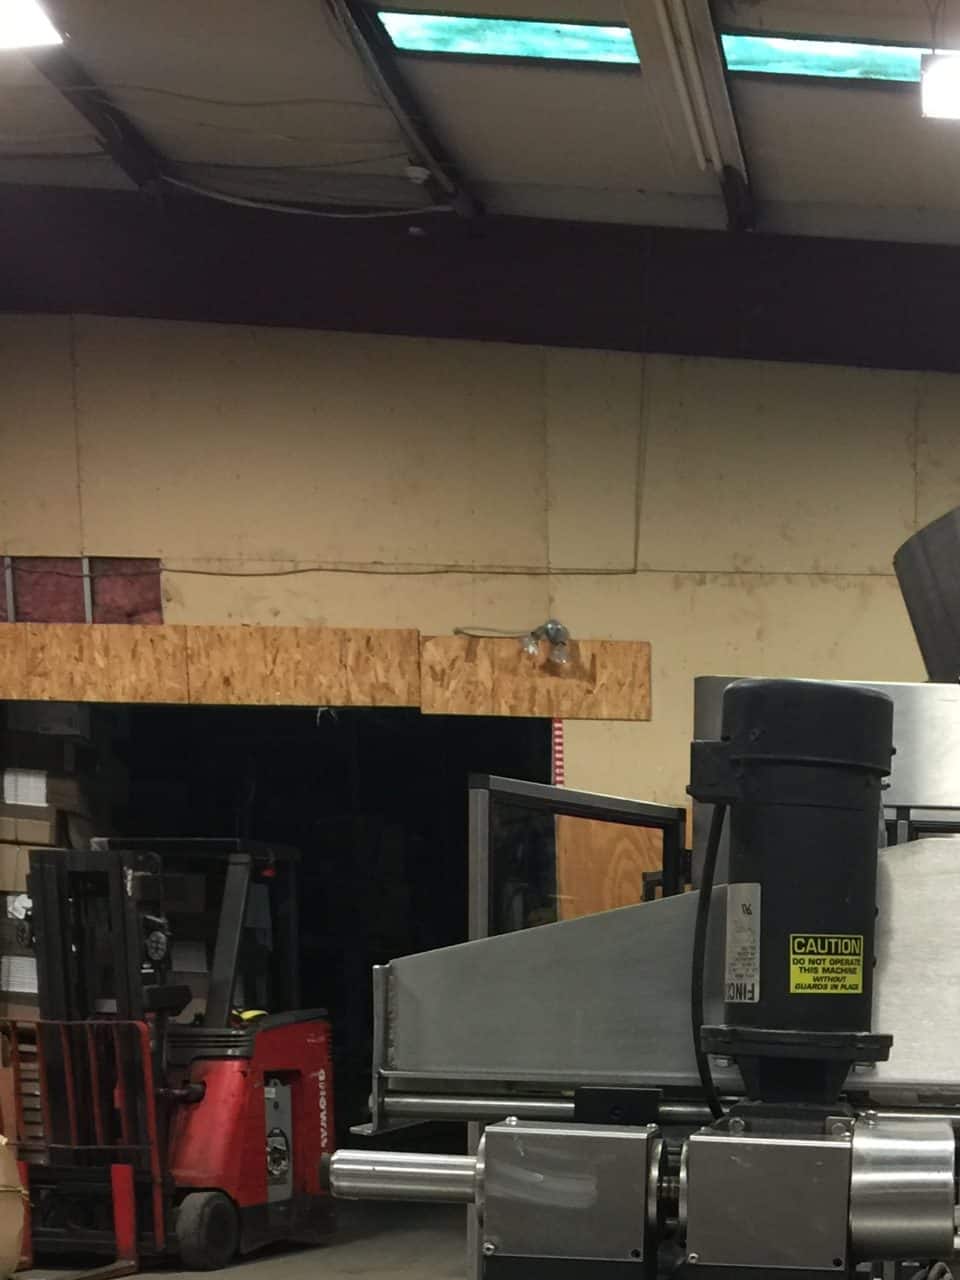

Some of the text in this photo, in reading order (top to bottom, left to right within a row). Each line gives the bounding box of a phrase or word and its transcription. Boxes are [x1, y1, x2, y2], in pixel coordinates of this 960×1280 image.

[794, 938, 860, 953] CAUTION
[793, 958, 861, 966] DO NOT OPERATE
